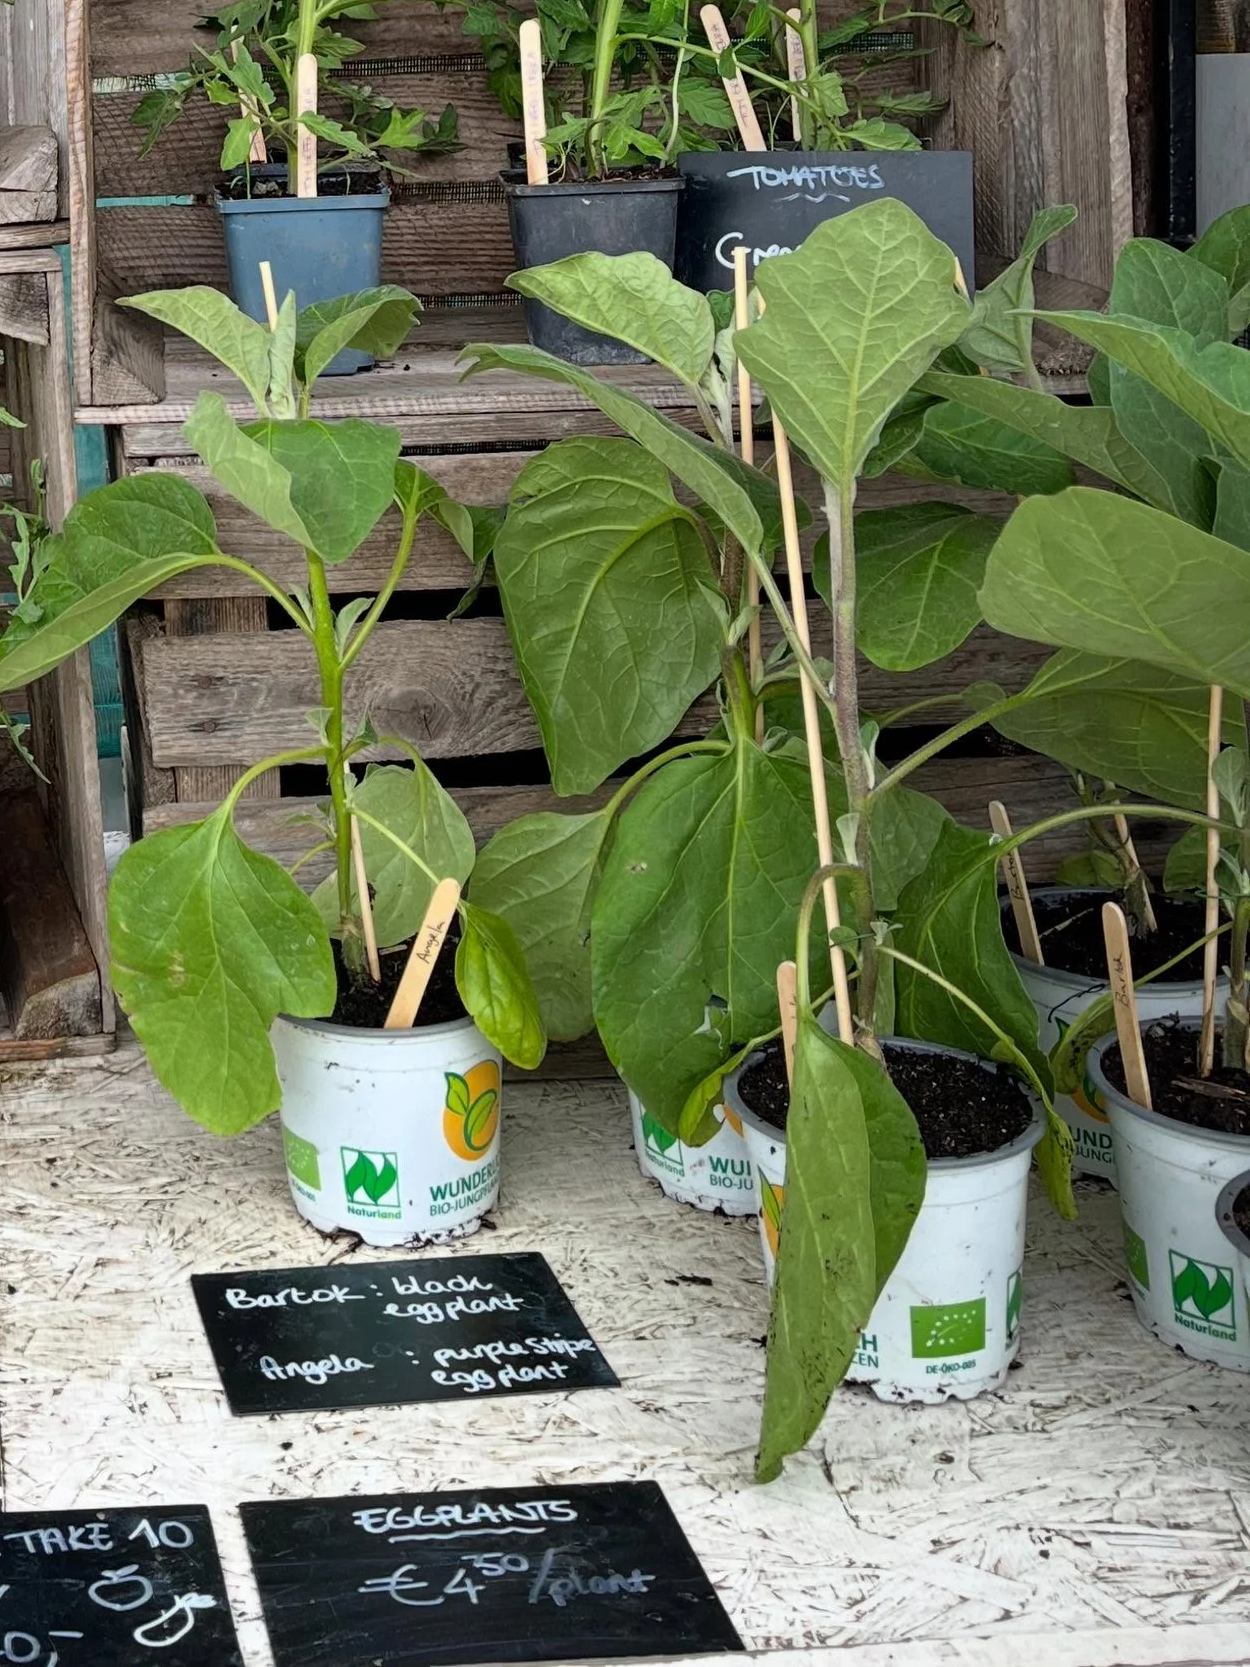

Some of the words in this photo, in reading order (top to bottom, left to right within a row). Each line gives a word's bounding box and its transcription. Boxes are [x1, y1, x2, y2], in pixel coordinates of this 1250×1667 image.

[726, 164, 886, 190] TOMATOES
[715, 231, 802, 269] Gree
[416, 922, 445, 964] Angela
[347, 1205, 402, 1219] Naturland
[391, 1274, 493, 1296] black
[854, 1333, 878, 1352] H
[1174, 1313, 1237, 1342] Naturland
[260, 1354, 375, 1385] Angela
[433, 1341, 530, 1368] purple
[352, 1499, 579, 1533] EGGPLANTS
[4, 1522, 114, 1554] TAKE
[128, 1520, 194, 1549] 10
